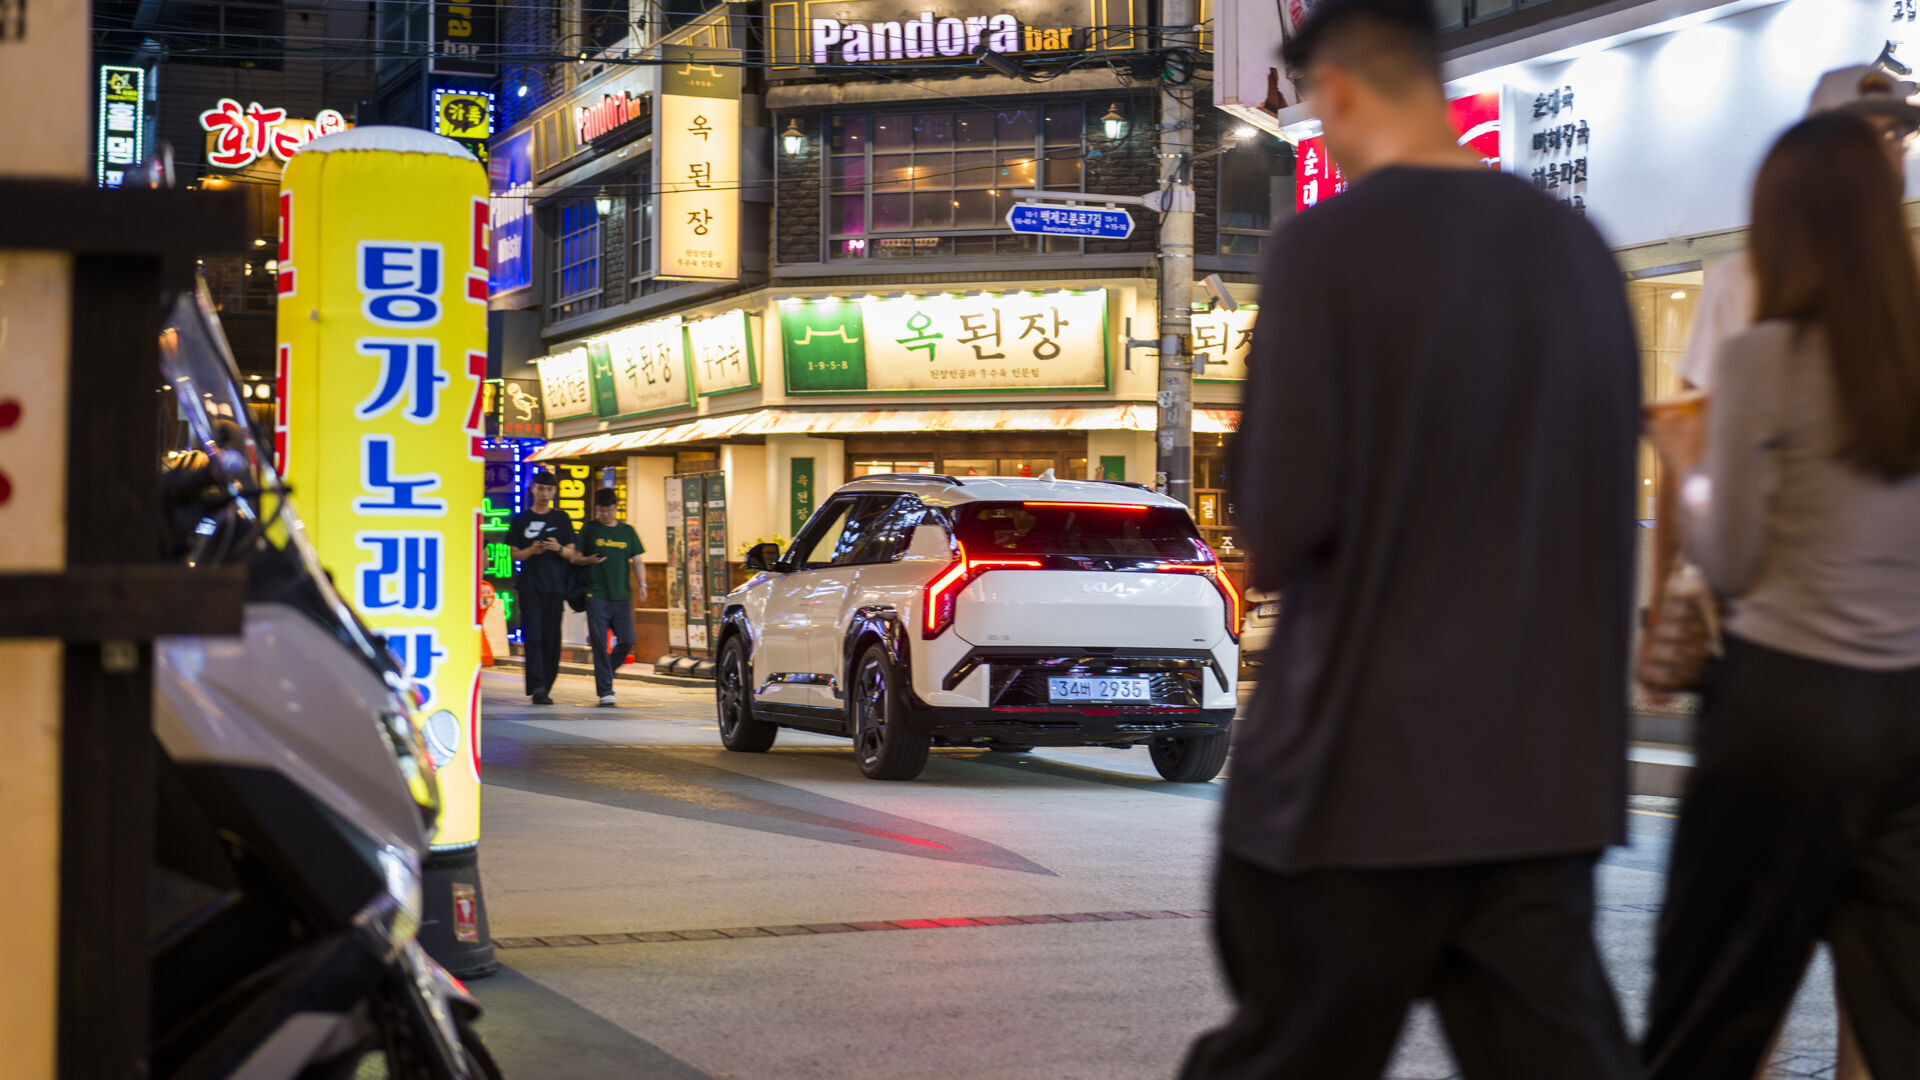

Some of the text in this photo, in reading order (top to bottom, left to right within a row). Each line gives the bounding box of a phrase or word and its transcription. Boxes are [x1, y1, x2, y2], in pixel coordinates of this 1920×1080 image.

[813, 11, 1073, 64] Pandora bar
[576, 89, 628, 145] Pandora
[687, 114, 713, 236] 옥된장
[1303, 148, 1320, 208] 순대
[1531, 157, 1589, 190] 해물파전
[1040, 210, 1102, 228] 백제고분로7길
[895, 306, 1069, 362] 옥된장
[624, 340, 673, 390] 옥된장
[1220, 536, 1235, 555] 주
[1058, 680, 1142, 698] 34버 2935
